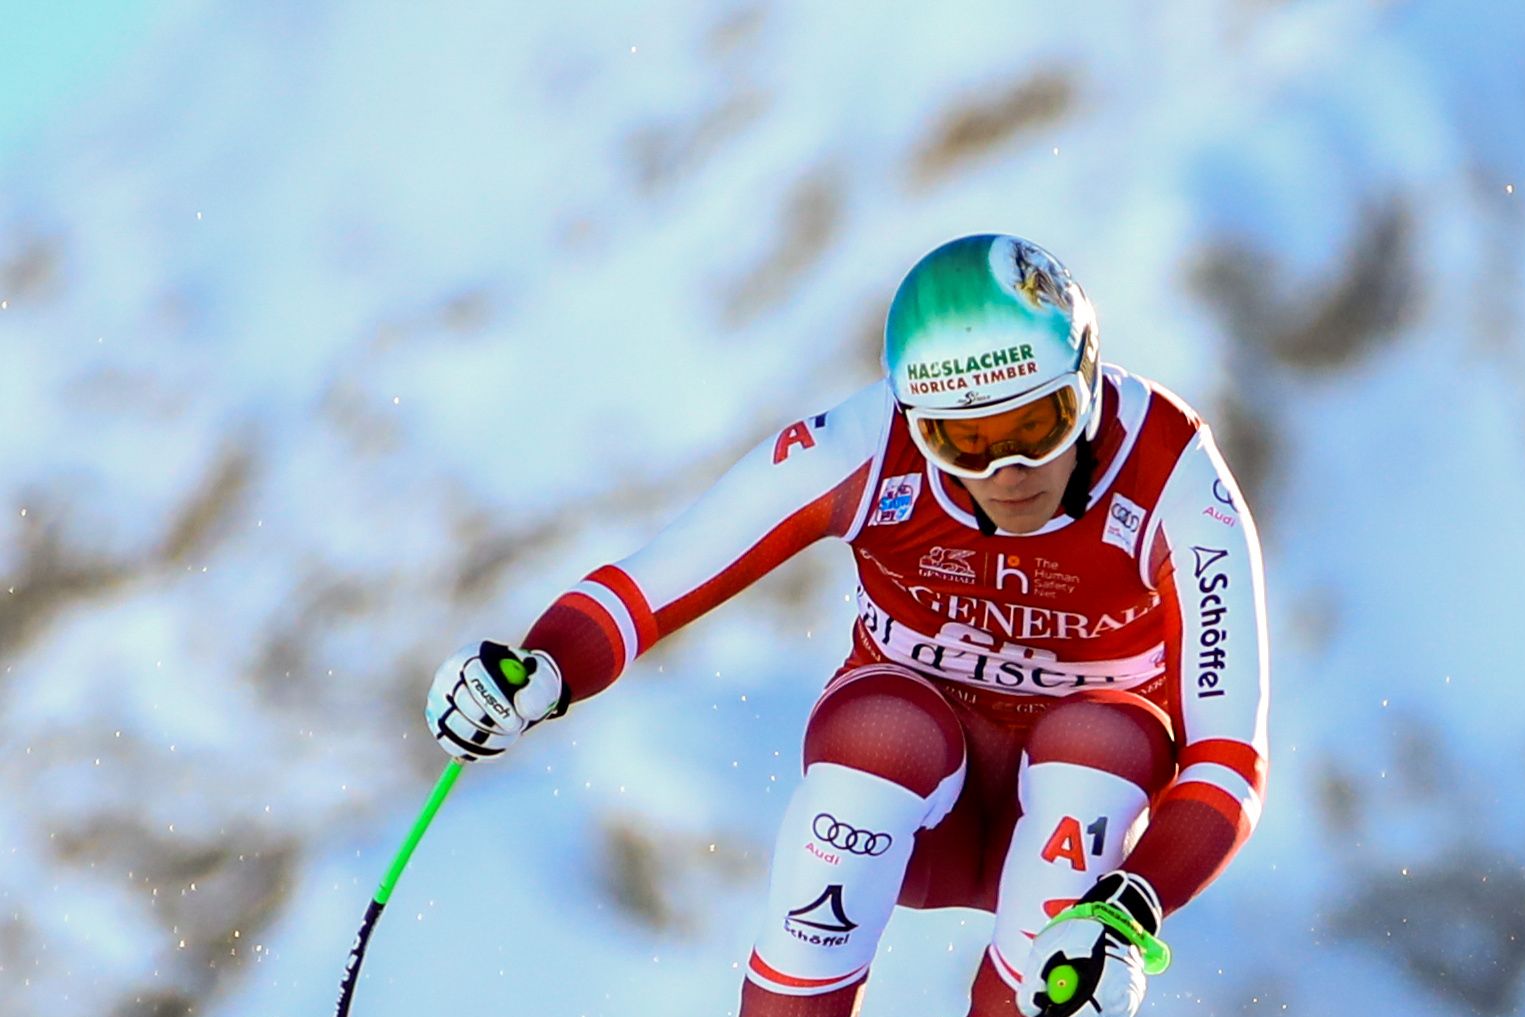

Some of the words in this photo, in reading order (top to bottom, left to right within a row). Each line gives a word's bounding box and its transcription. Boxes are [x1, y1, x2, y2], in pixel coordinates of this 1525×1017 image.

[907, 343, 1035, 381] HASSLACHER
[910, 377, 968, 395] NORICA
[975, 362, 1038, 386] TIMBER
[1203, 506, 1237, 528] Audi
[1034, 557, 1059, 570] The
[1034, 568, 1080, 583] Human
[1198, 572, 1229, 698] Schöffel
[471, 678, 511, 719] reusch
[805, 842, 840, 865] Audi
[1041, 815, 1108, 871] A1
